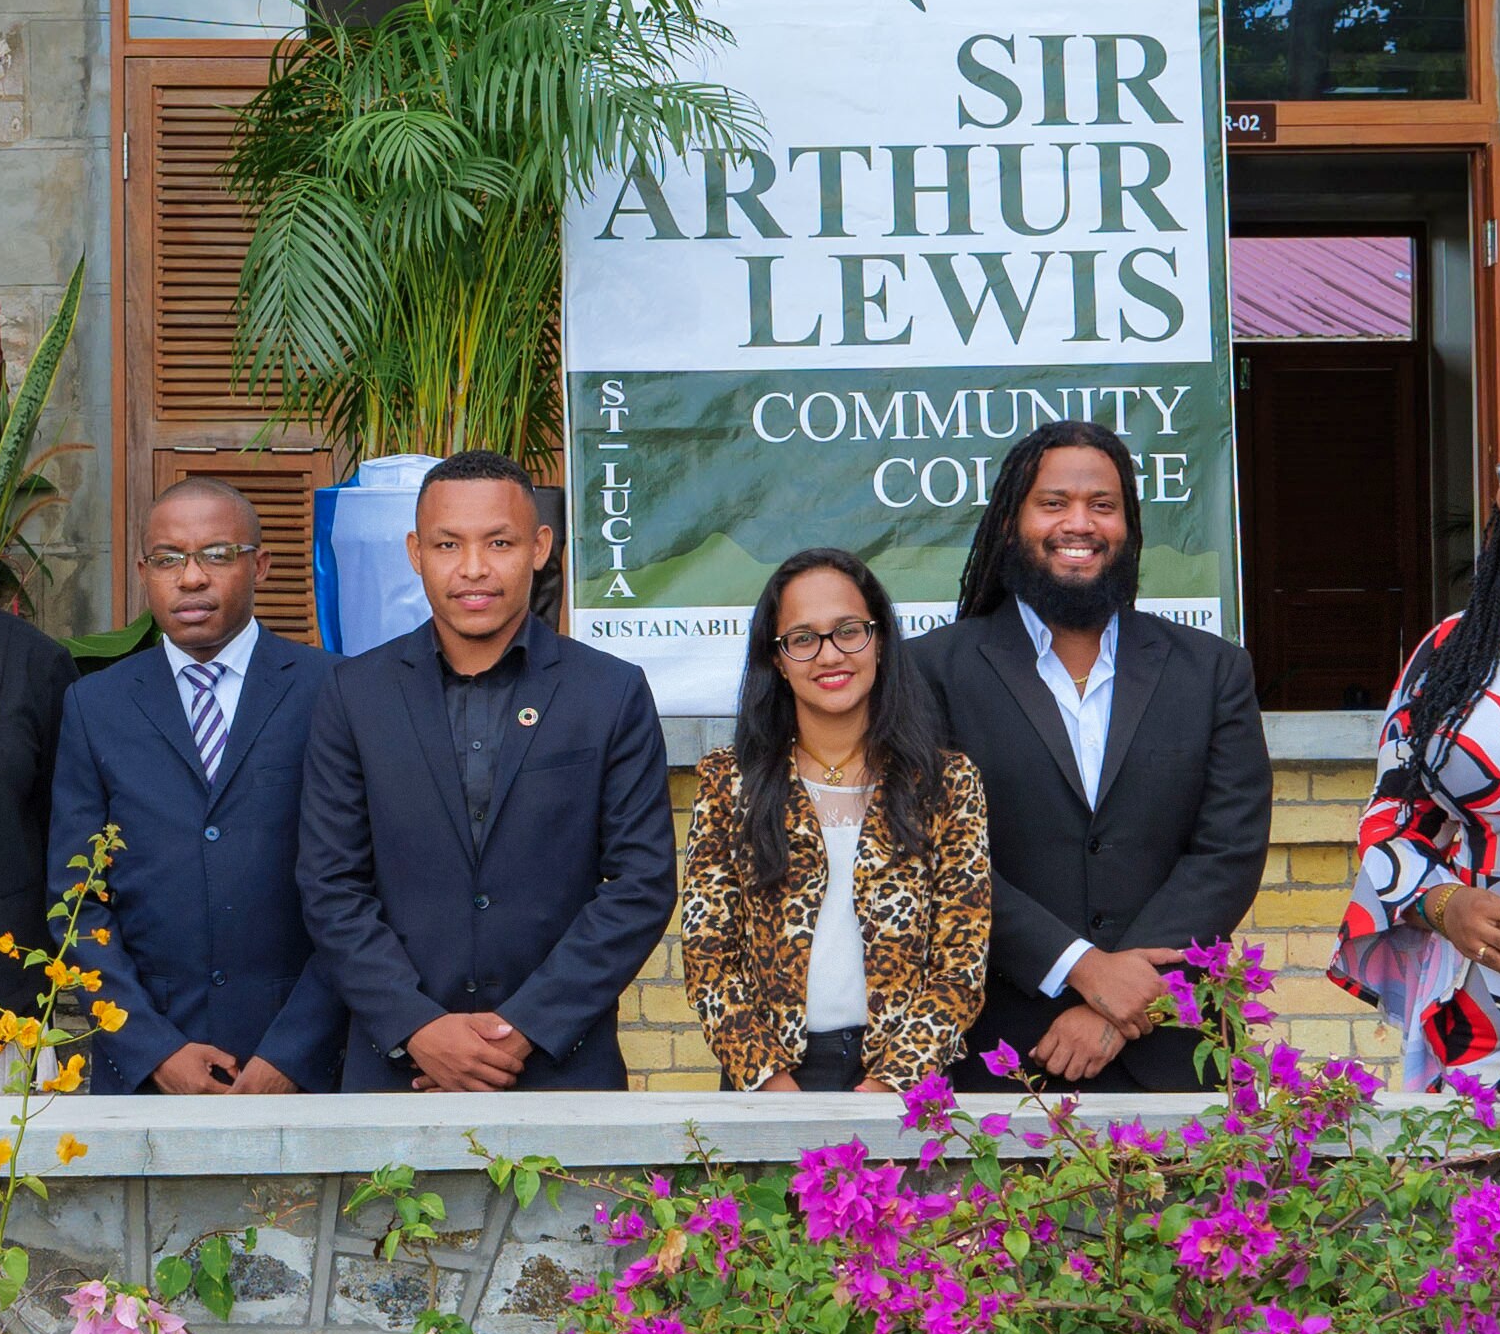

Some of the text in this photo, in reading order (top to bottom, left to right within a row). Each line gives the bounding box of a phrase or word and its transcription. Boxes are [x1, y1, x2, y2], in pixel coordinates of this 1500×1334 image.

[956, 34, 1184, 129] SIR
[594, 141, 1188, 242] ARTHUR
[738, 246, 1185, 350] LEWIS
[751, 385, 1193, 444] COMMUNITY
[873, 453, 1193, 509] COLE
[591, 619, 752, 638] SUSTAINABIL
